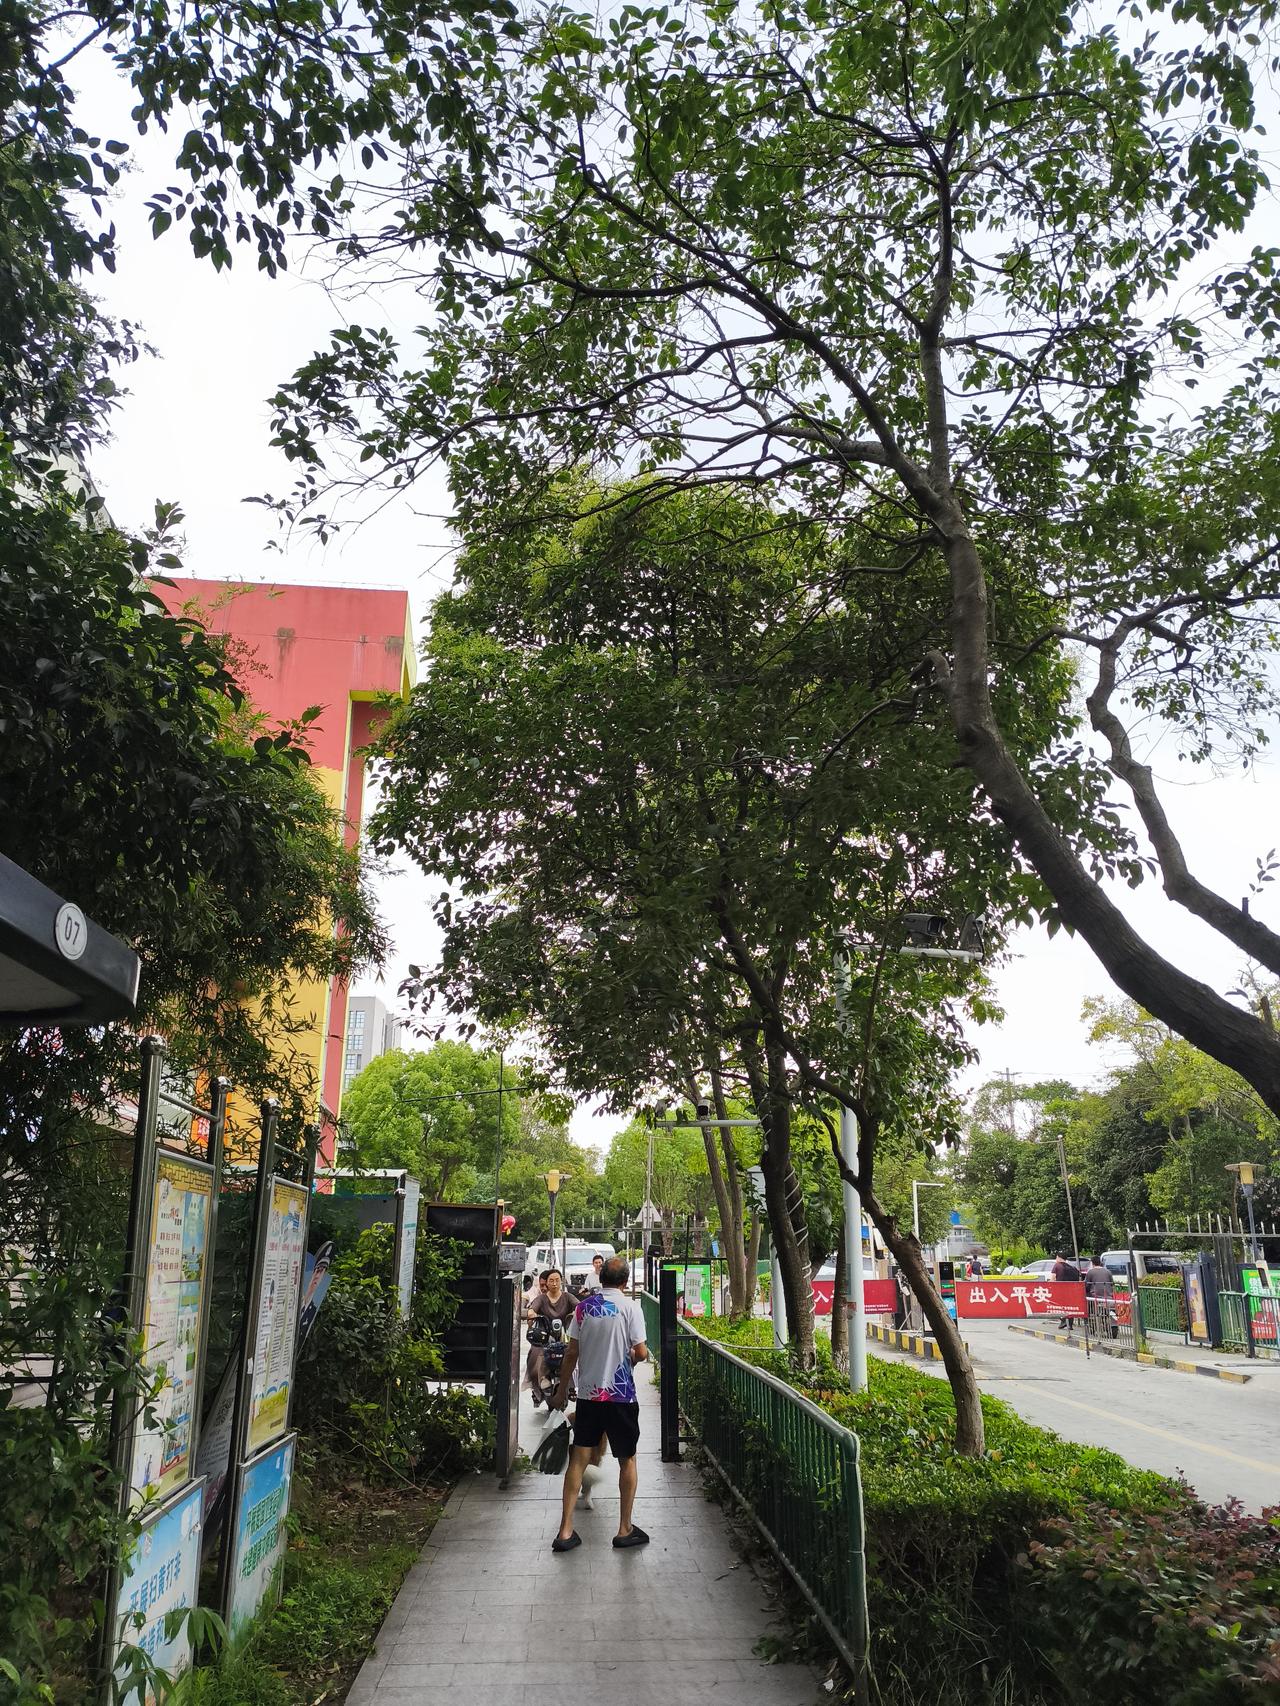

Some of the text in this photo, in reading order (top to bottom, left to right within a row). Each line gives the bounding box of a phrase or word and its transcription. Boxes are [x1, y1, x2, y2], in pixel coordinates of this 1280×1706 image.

[65, 916, 80, 945] 07
[969, 1286, 1052, 1303] 出入平安
